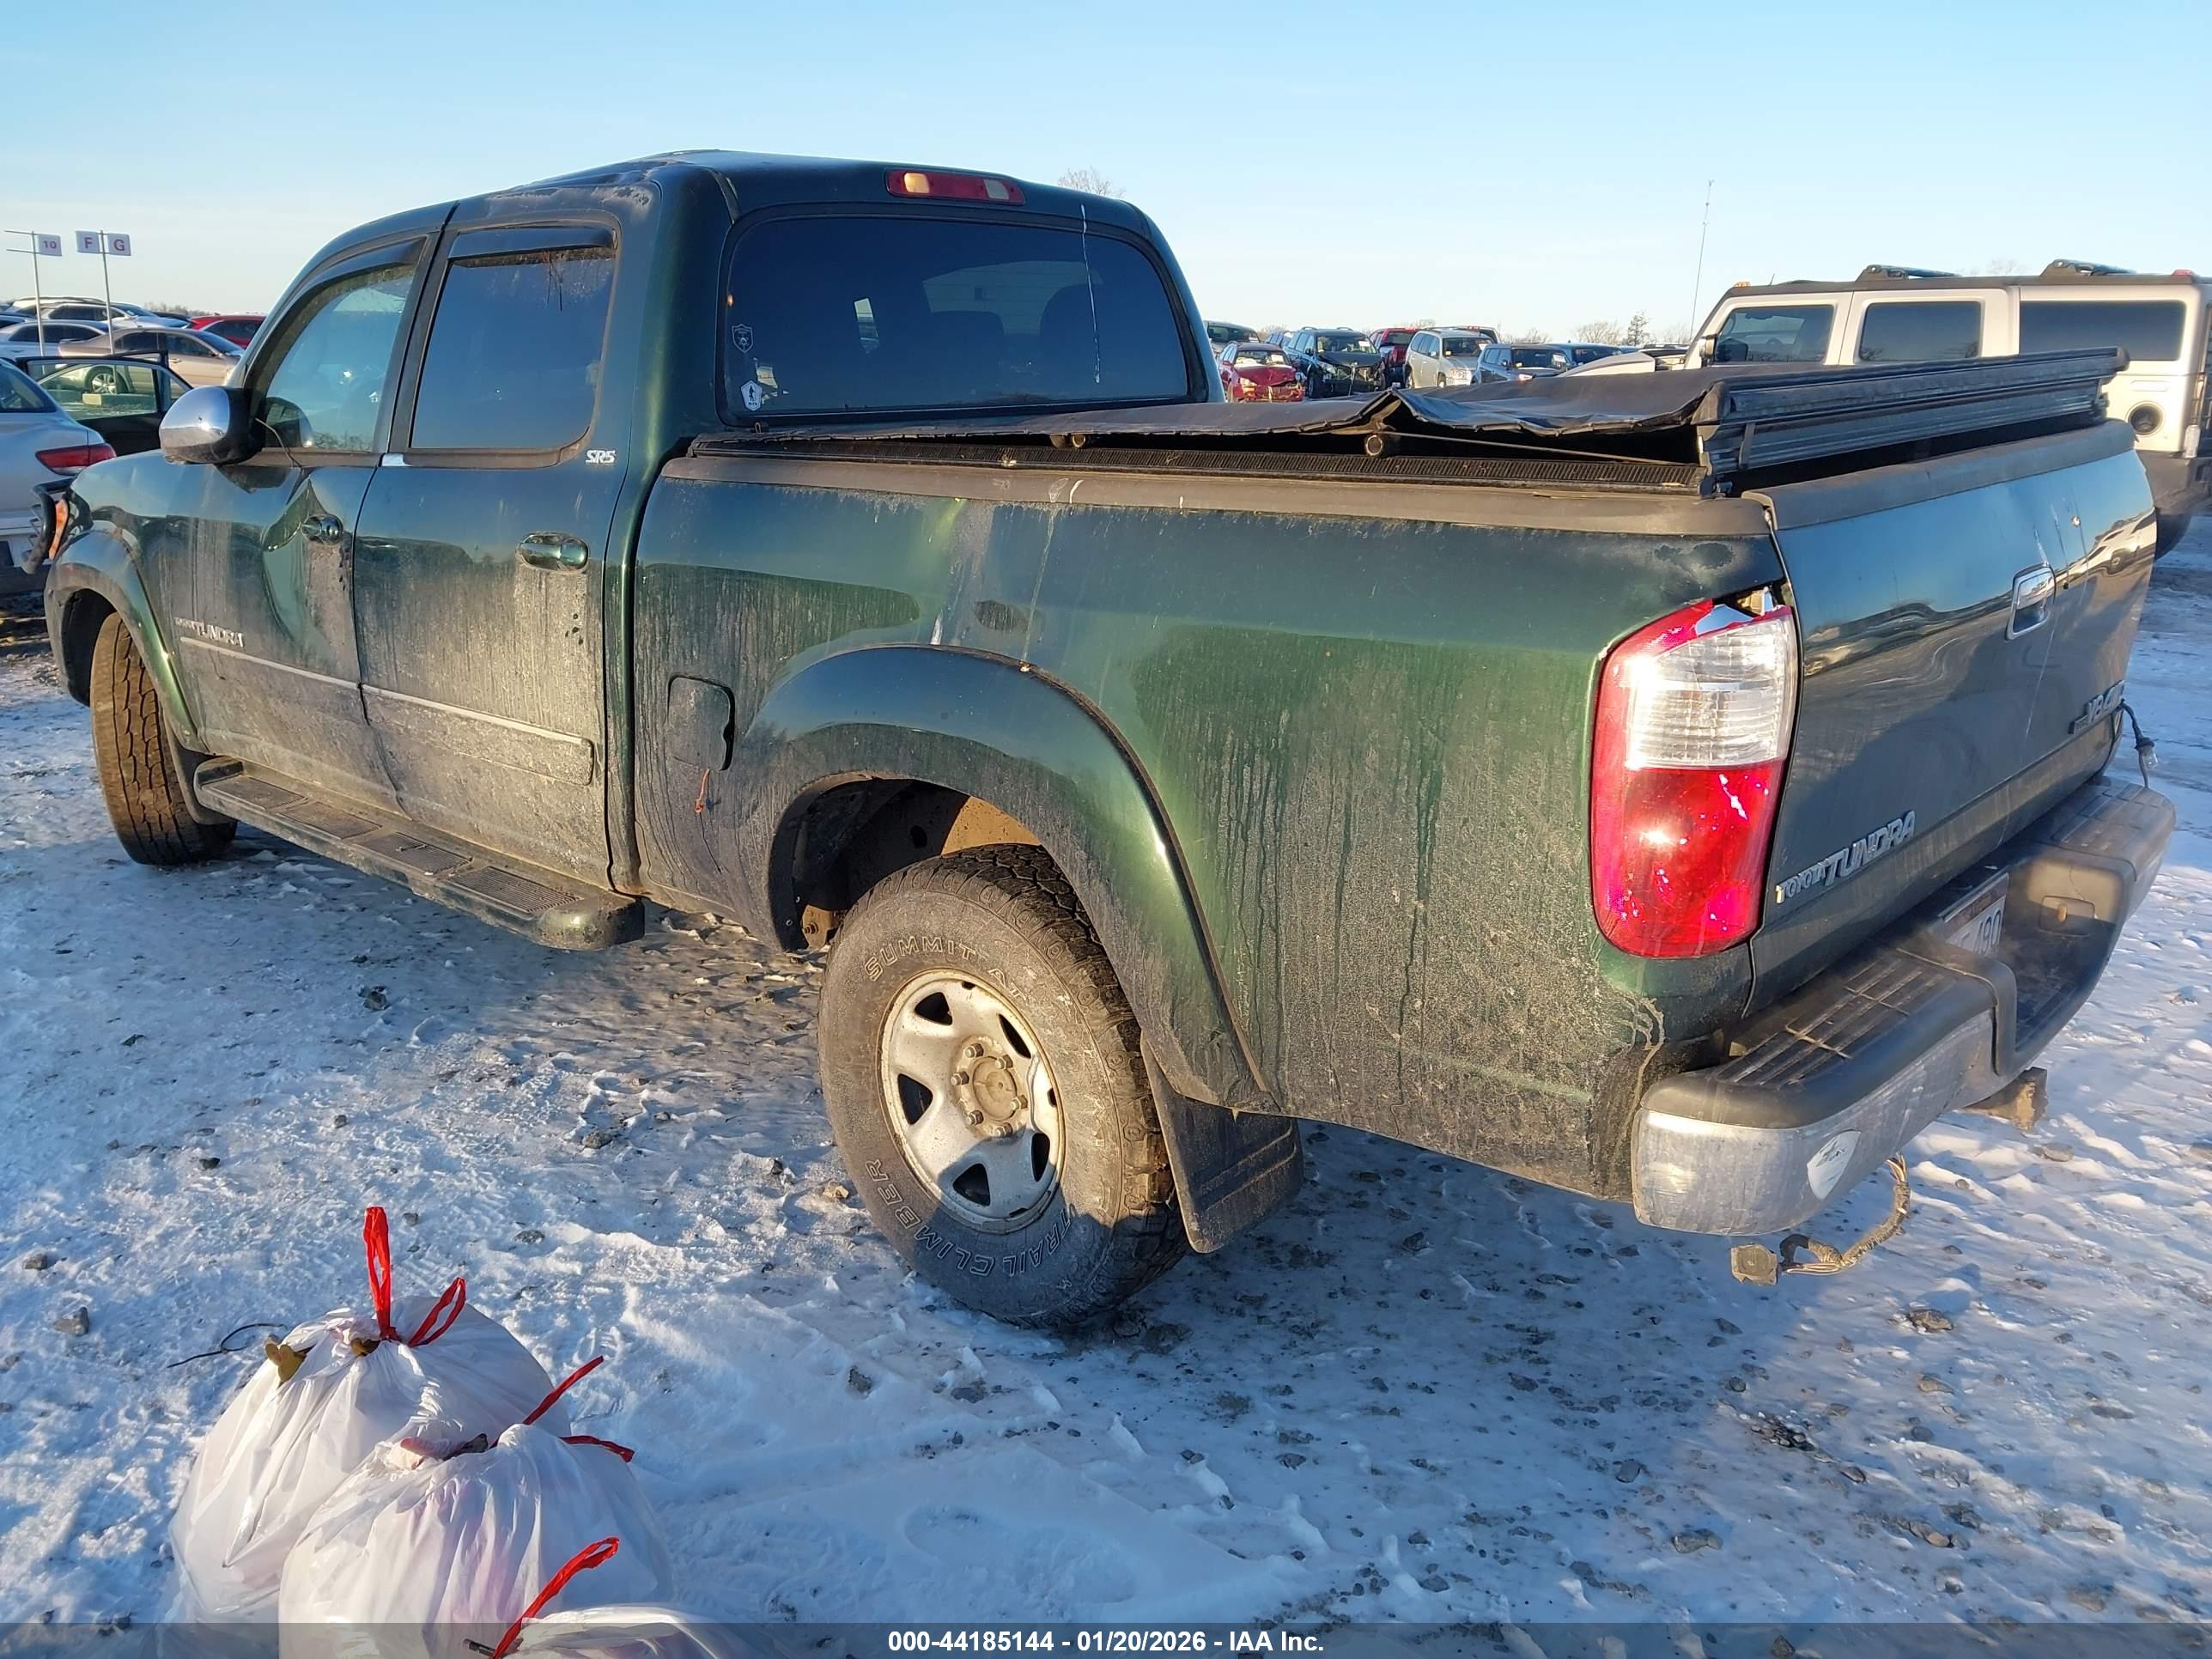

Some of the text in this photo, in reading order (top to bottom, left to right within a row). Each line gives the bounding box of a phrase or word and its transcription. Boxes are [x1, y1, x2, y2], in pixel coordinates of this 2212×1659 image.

[43, 240, 57, 249] 10
[83, 236, 93, 249] F
[113, 239, 125, 251] G
[586, 449, 616, 464] SR5
[1825, 811, 1916, 887] TUNDRA
[1776, 861, 1826, 903] TOYOTA
[865, 935, 1027, 1001] SUMMIT AT
